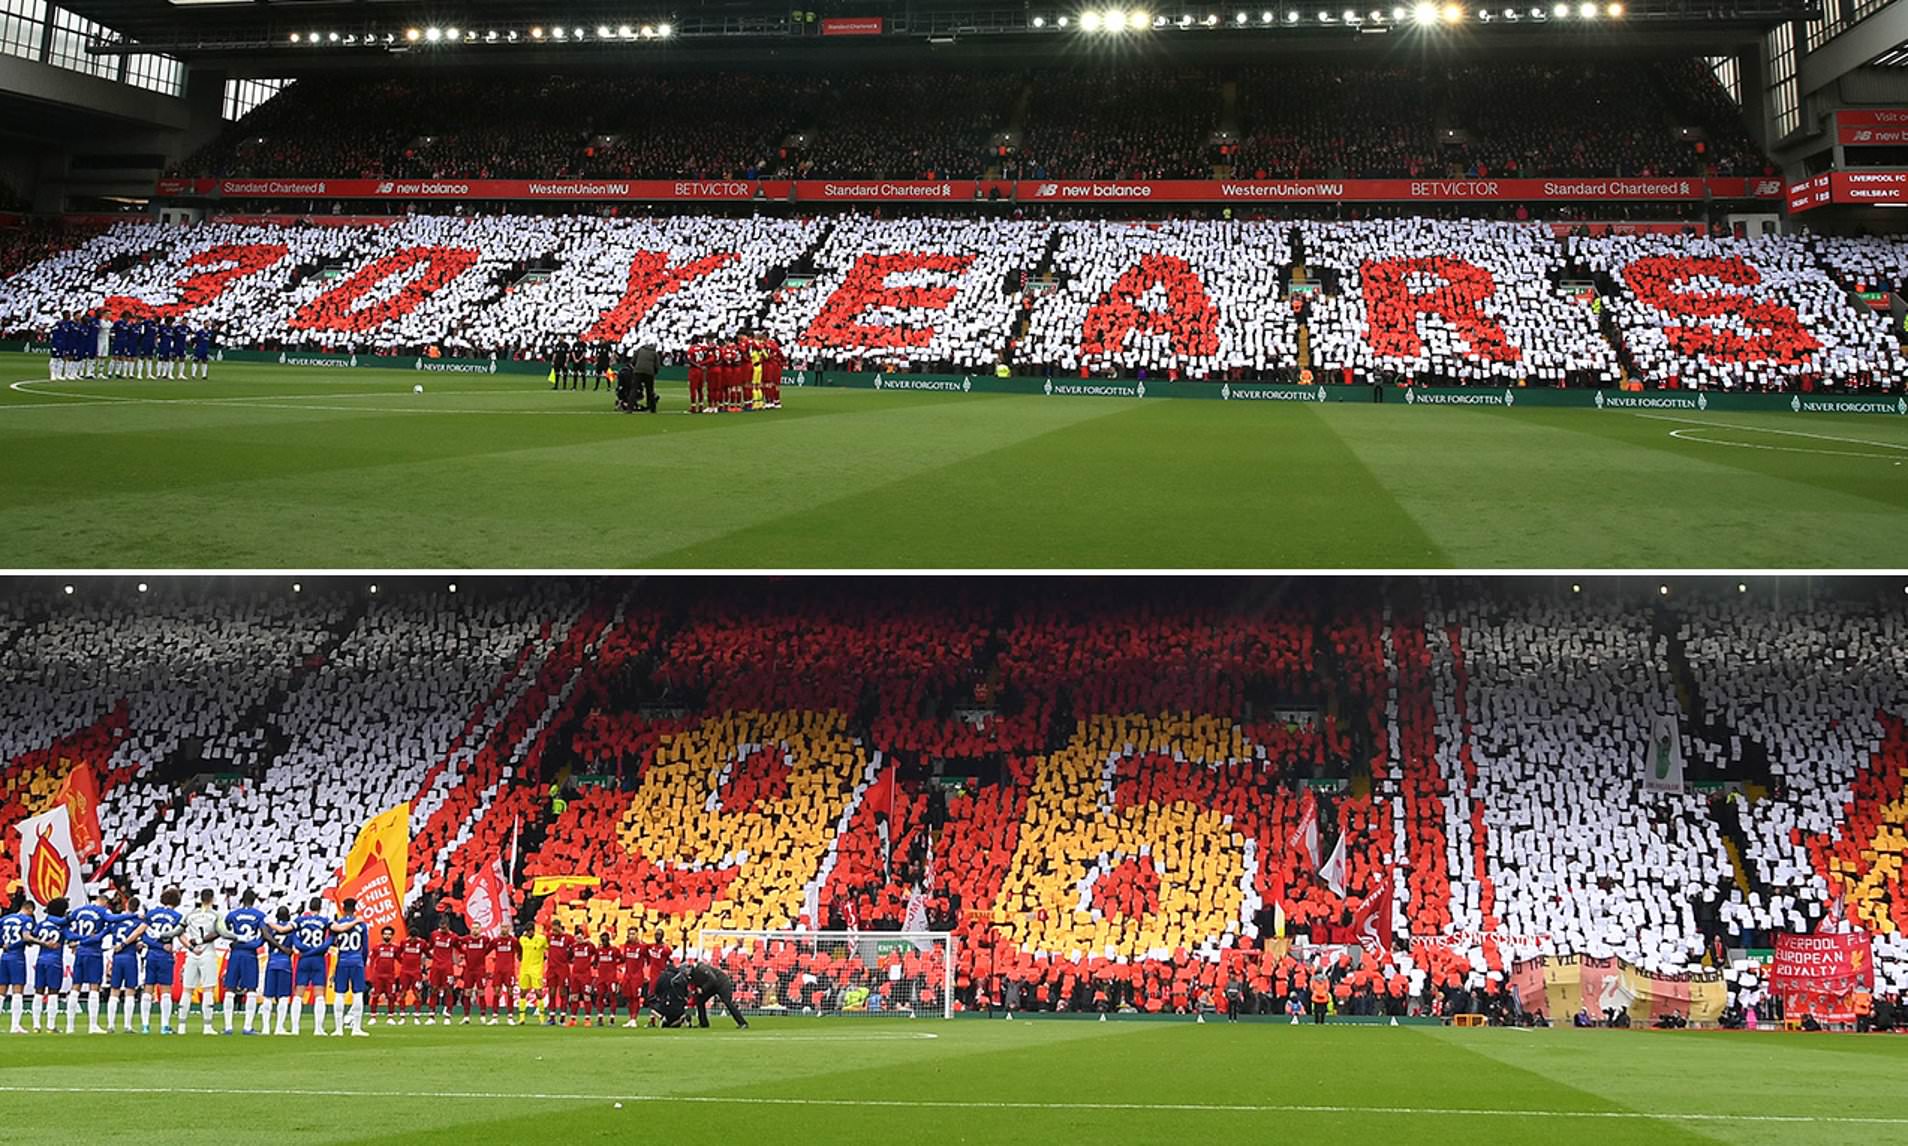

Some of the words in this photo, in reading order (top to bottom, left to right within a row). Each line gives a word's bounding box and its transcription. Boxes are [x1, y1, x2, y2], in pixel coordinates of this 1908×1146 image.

[1875, 132, 1899, 141] new
[1849, 174, 1894, 182] LIVERPOOL
[1895, 174, 1906, 182] FC
[224, 182, 268, 193] Standard
[269, 181, 319, 193] Chartered
[397, 185, 420, 194] new
[422, 183, 468, 194] balance
[824, 183, 880, 196] Standard
[881, 183, 940, 196] Chartered
[1062, 186, 1090, 196] new
[1093, 183, 1151, 196] balance
[1544, 182, 1606, 195] Standard
[1609, 181, 1678, 195] Chartered
[1850, 189, 1888, 197] CHELSEA
[1889, 189, 1900, 197] FC
[287, 357, 308, 366] NEVER
[310, 358, 349, 368] FORGOTTEN
[424, 362, 445, 372] NEVER
[446, 363, 487, 373] FORGOTTEN
[884, 379, 910, 389] NEVER
[911, 380, 960, 390] FORGOTTEN
[1055, 385, 1081, 395] NEVER
[1083, 385, 1135, 396] FORGOTTEN
[1232, 390, 1260, 400] NEVER
[1262, 390, 1316, 401] FORGOTTEN
[1417, 394, 1446, 404] NEVER
[1448, 394, 1502, 405] FORGOTTEN
[1606, 397, 1637, 408] NEVER
[1638, 398, 1695, 409] FORGOTTEN
[1804, 401, 1835, 412] NEVER
[1836, 402, 1896, 413] FORGOTTEN
[365, 886, 392, 902] HILL
[363, 898, 395, 919] OUR
[374, 909, 398, 926] WAY
[2, 925, 22, 944] 33
[38, 928, 60, 944] 22
[116, 926, 127, 943] 5
[300, 928, 323, 948] 28
[337, 931, 361, 951] 20
[1529, 956, 1549, 971] THE
[1557, 953, 1611, 969] VICTIMS
[1775, 948, 1843, 965] EUROPEAN
[1776, 964, 1838, 977] ROYALTY
